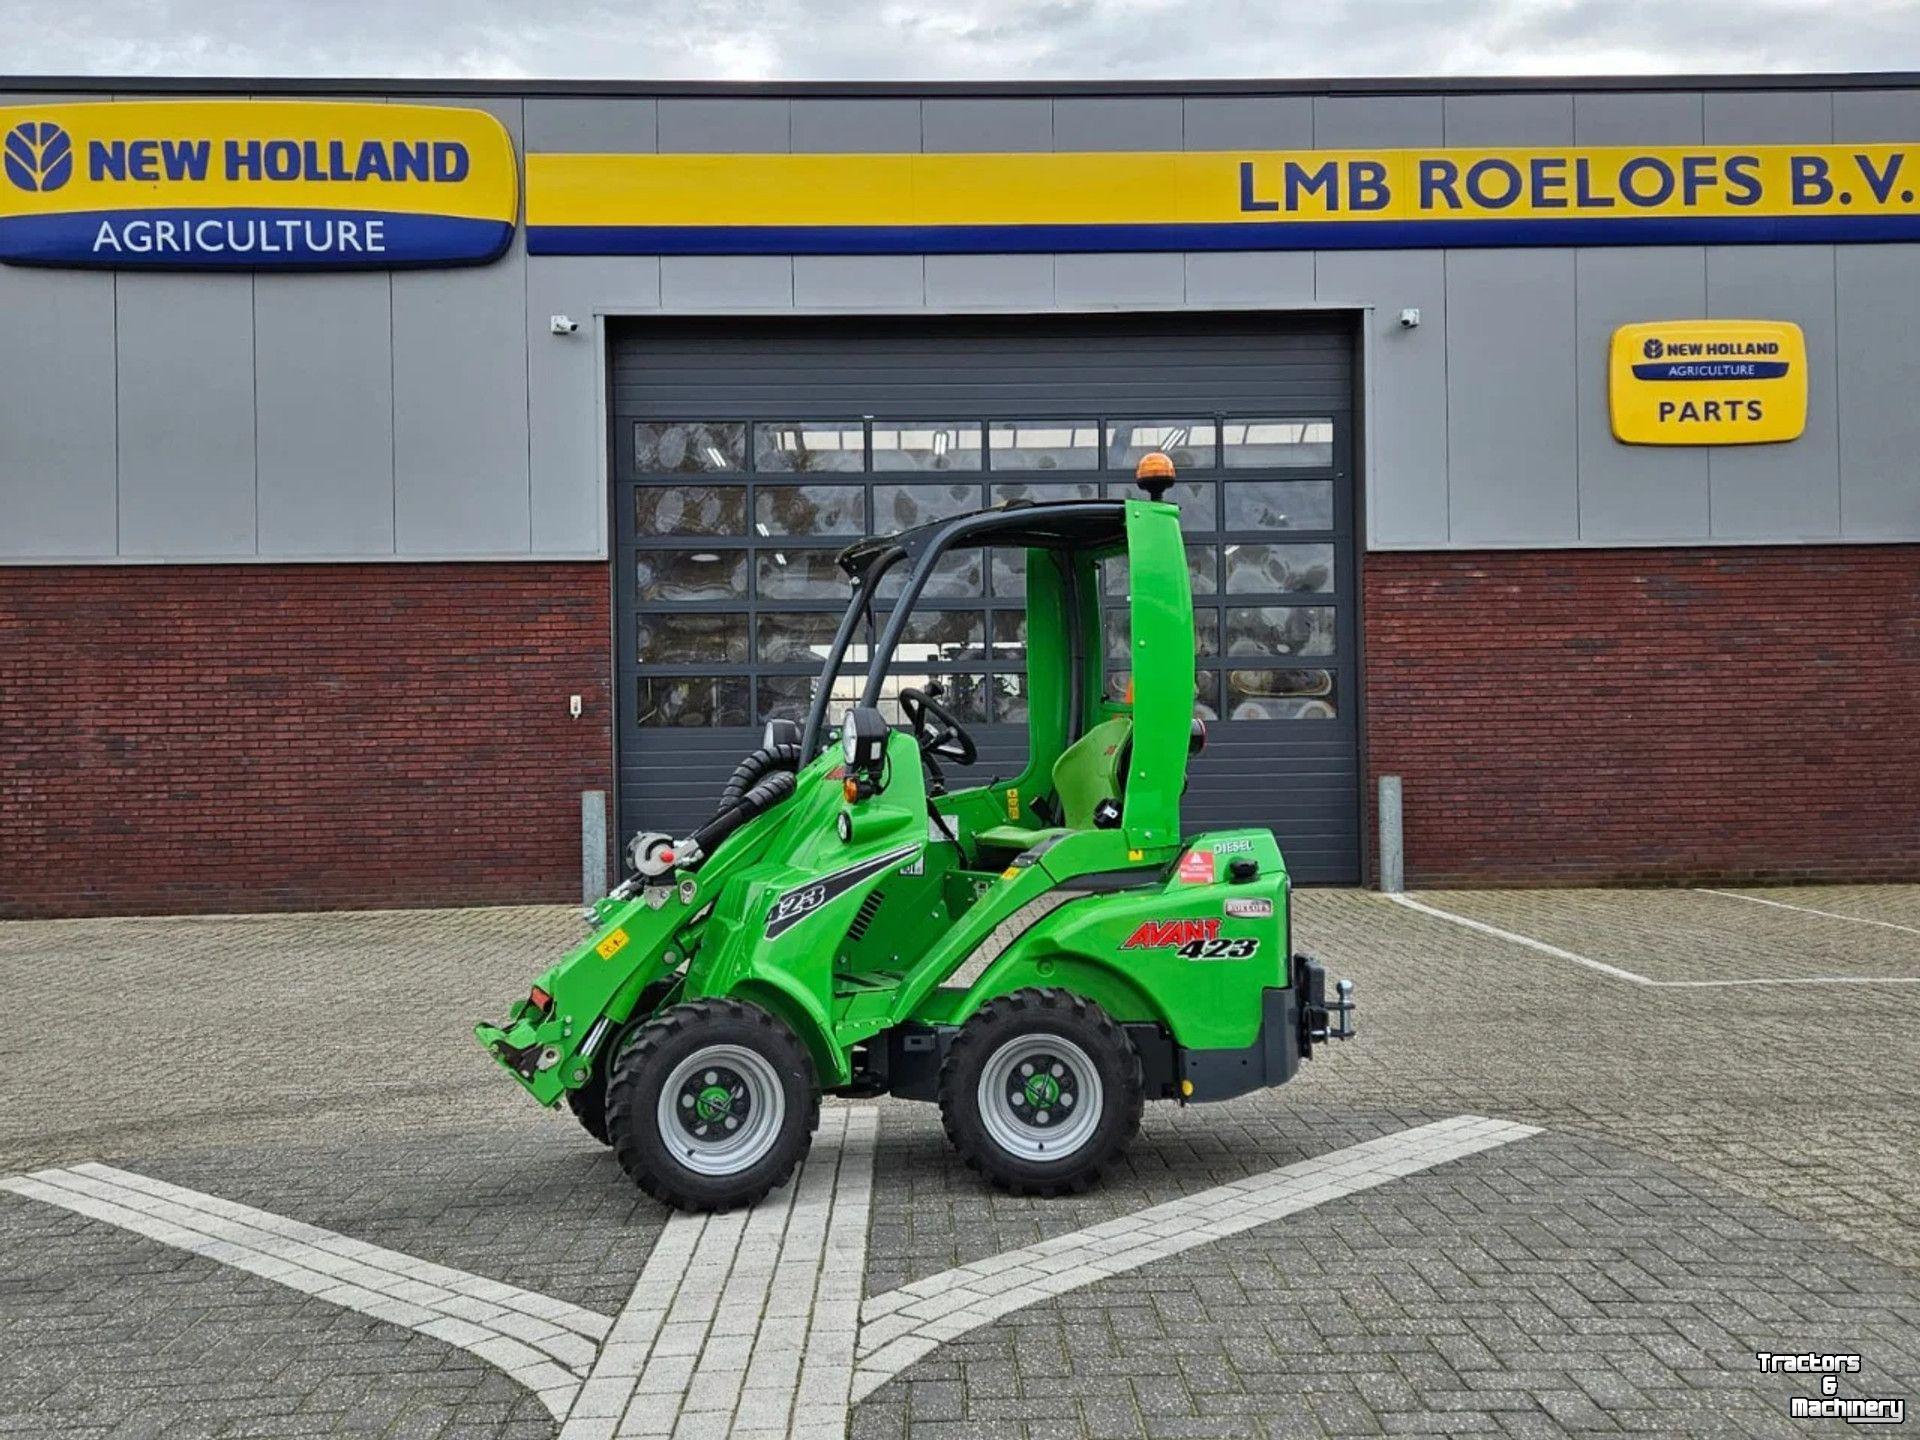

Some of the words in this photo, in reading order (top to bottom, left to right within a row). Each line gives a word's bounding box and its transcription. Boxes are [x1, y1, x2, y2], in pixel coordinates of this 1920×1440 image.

[89, 140, 210, 182] NEW
[225, 140, 470, 183] HOLLAND
[1240, 161, 1391, 212] LMB
[1419, 156, 1763, 210] ROELOFS
[1790, 152, 1915, 207] B.V.
[92, 220, 387, 253] AGRICULTURE
[1667, 344, 1703, 356] NEW
[1706, 342, 1779, 356] HOLLAND
[1668, 364, 1755, 377] AGRICULTURE
[1659, 401, 1763, 422] PARTS
[1213, 840, 1254, 855] DIESEL
[1118, 918, 1222, 950] AVANT
[1175, 938, 1260, 960] 423
